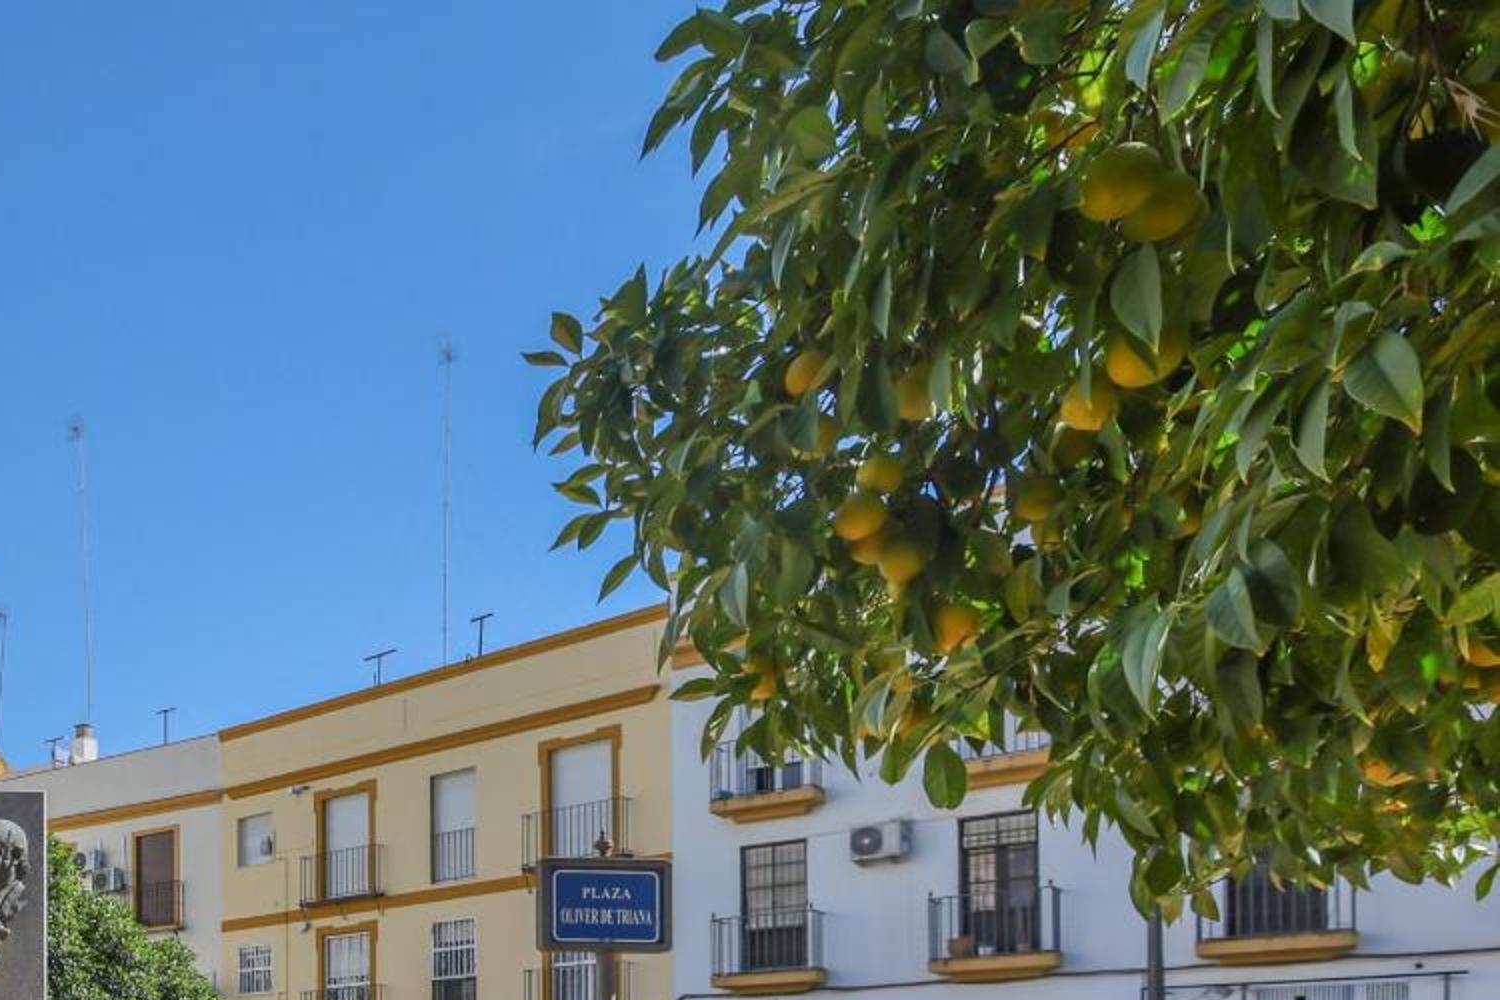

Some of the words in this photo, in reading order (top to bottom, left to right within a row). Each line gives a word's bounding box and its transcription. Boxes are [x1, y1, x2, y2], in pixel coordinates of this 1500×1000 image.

[581, 887, 632, 899] PLAZA
[561, 907, 599, 925] OLIVER
[600, 908, 614, 925] DE
[616, 908, 653, 926] TRIANA
